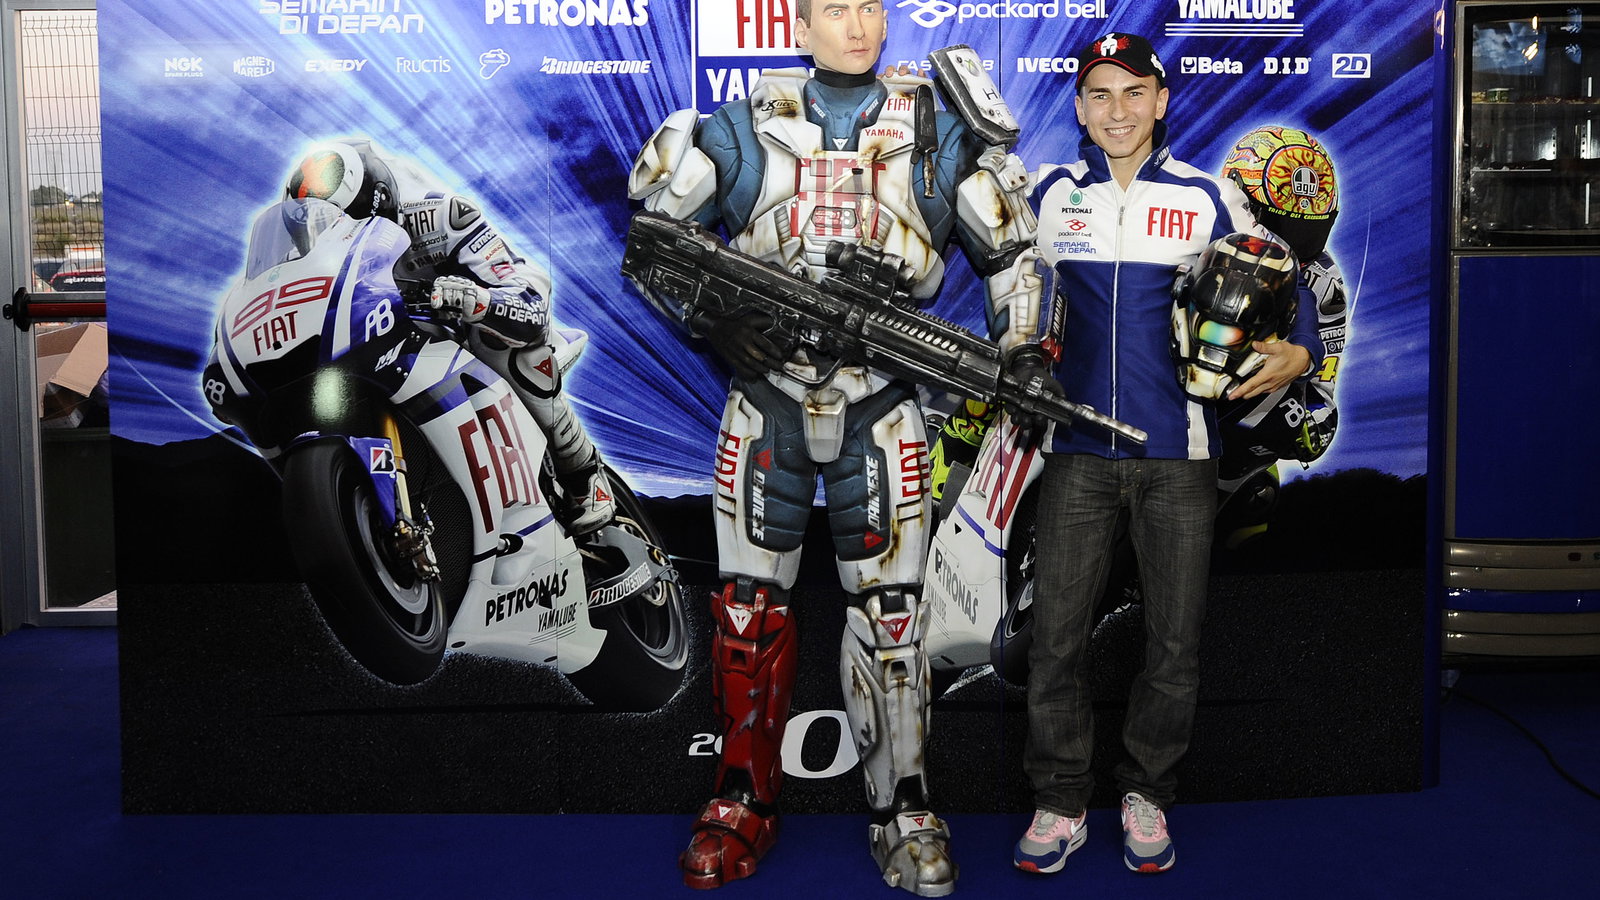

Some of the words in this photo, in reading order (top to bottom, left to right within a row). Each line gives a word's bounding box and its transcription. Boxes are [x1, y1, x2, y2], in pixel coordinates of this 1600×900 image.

[485, 0, 649, 27] PETRONAS
[958, 0, 1058, 24] packard
[1177, 0, 1295, 20] YAMALUBE
[279, 15, 309, 35] DI
[317, 14, 424, 35] DEPAN
[736, 0, 802, 48] FIA
[164, 57, 203, 72] NGK
[305, 59, 368, 72] EXEDY
[540, 56, 652, 74] BRIDGESTONE
[1017, 57, 1080, 73] IVECO
[1198, 57, 1243, 74] Beta
[1335, 57, 1368, 75] 2D
[886, 98, 912, 112] FIAT
[864, 129, 905, 141] YAMAHA
[404, 208, 436, 238] FIAT
[1061, 207, 1093, 215] PETRONAS
[1146, 206, 1199, 241] FIAT
[1067, 247, 1097, 255] DEPAN
[494, 303, 508, 317] DI
[508, 306, 546, 326] DEPAN
[252, 310, 299, 357] FIAT
[1316, 356, 1339, 382] 4
[457, 391, 541, 534] FIAT
[714, 428, 742, 495] FIAT
[898, 438, 931, 499] FIAT
[752, 468, 767, 542] DAINESE
[866, 455, 881, 531] DAINESE
[486, 568, 569, 627] PETRONAS
[538, 602, 578, 633] YAMALUBE
